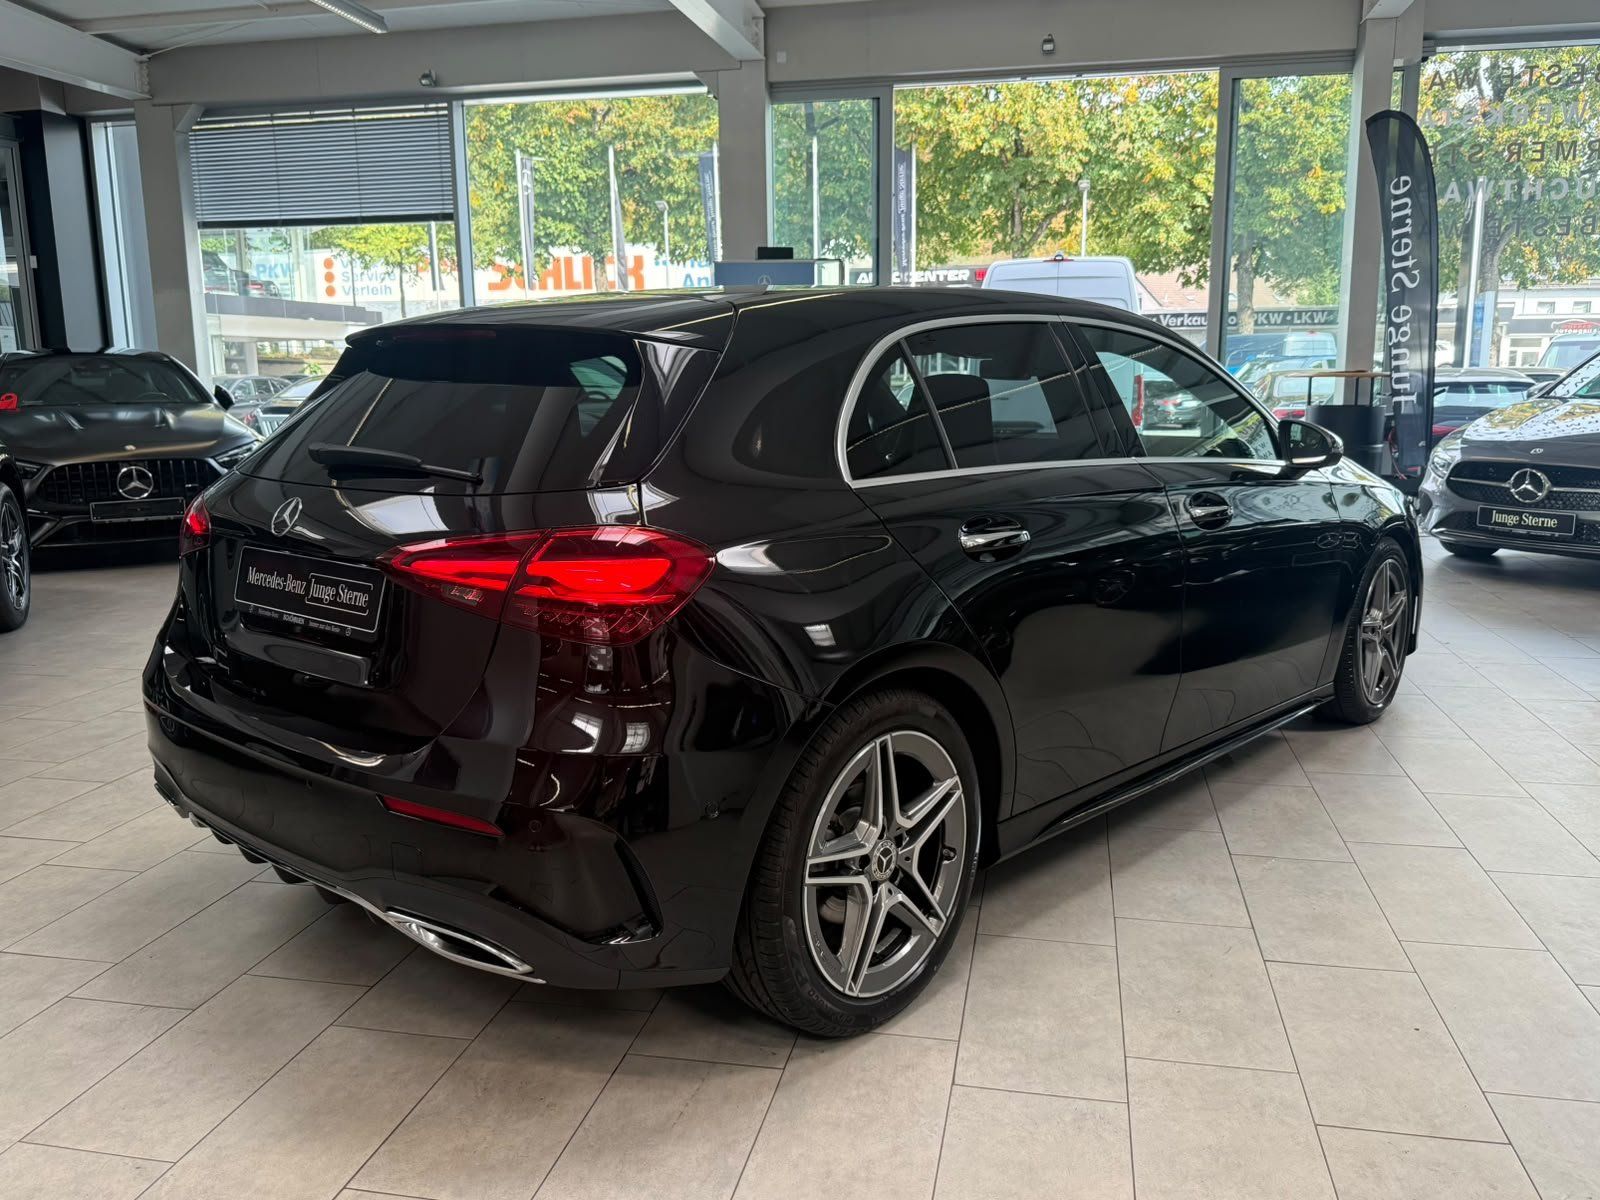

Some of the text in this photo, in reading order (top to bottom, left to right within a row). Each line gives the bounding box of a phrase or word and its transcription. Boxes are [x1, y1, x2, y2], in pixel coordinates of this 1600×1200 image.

[1292, 311, 1328, 324] LKW
[1491, 509, 1558, 528] Junge Sterne
[246, 565, 369, 608] Mercedes-Benz Junge Sterne
